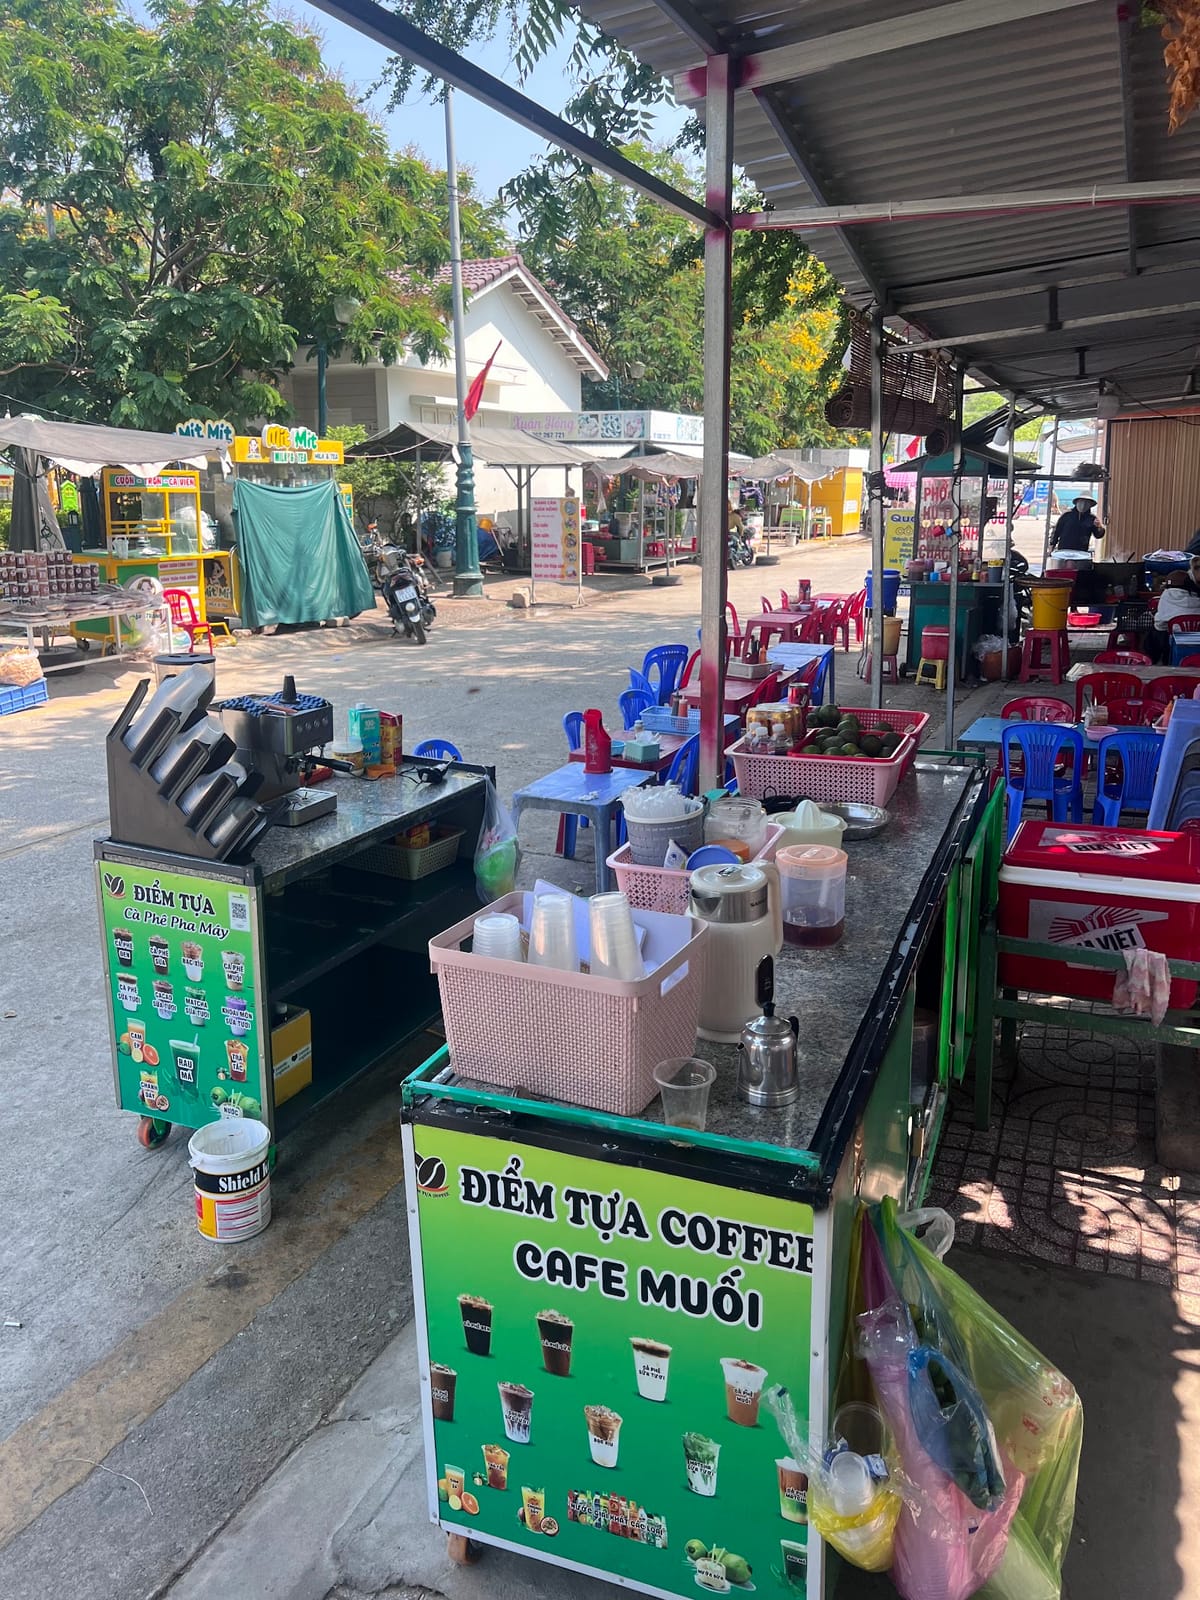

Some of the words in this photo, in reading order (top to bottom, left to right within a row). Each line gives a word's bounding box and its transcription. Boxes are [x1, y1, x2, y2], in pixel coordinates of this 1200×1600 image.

[266, 426, 291, 449] Mit
[294, 428, 319, 450] Mit
[133, 879, 175, 908] ĐIỂM
[178, 893, 215, 917] TỰA
[124, 907, 141, 921] Cà
[144, 911, 167, 926] Phê
[171, 917, 196, 932] Pha
[199, 921, 230, 940] Máy
[130, 1032, 143, 1041] CAM
[178, 1057, 193, 1069] RAU
[180, 1069, 193, 1082] MÁ
[218, 1166, 261, 1193] Shield
[460, 1157, 554, 1220] ĐIỂM
[564, 1190, 650, 1242] TỰA
[660, 1210, 814, 1273] COFFEE
[515, 1242, 627, 1299] CAFE
[639, 1267, 761, 1329] MUỐI
